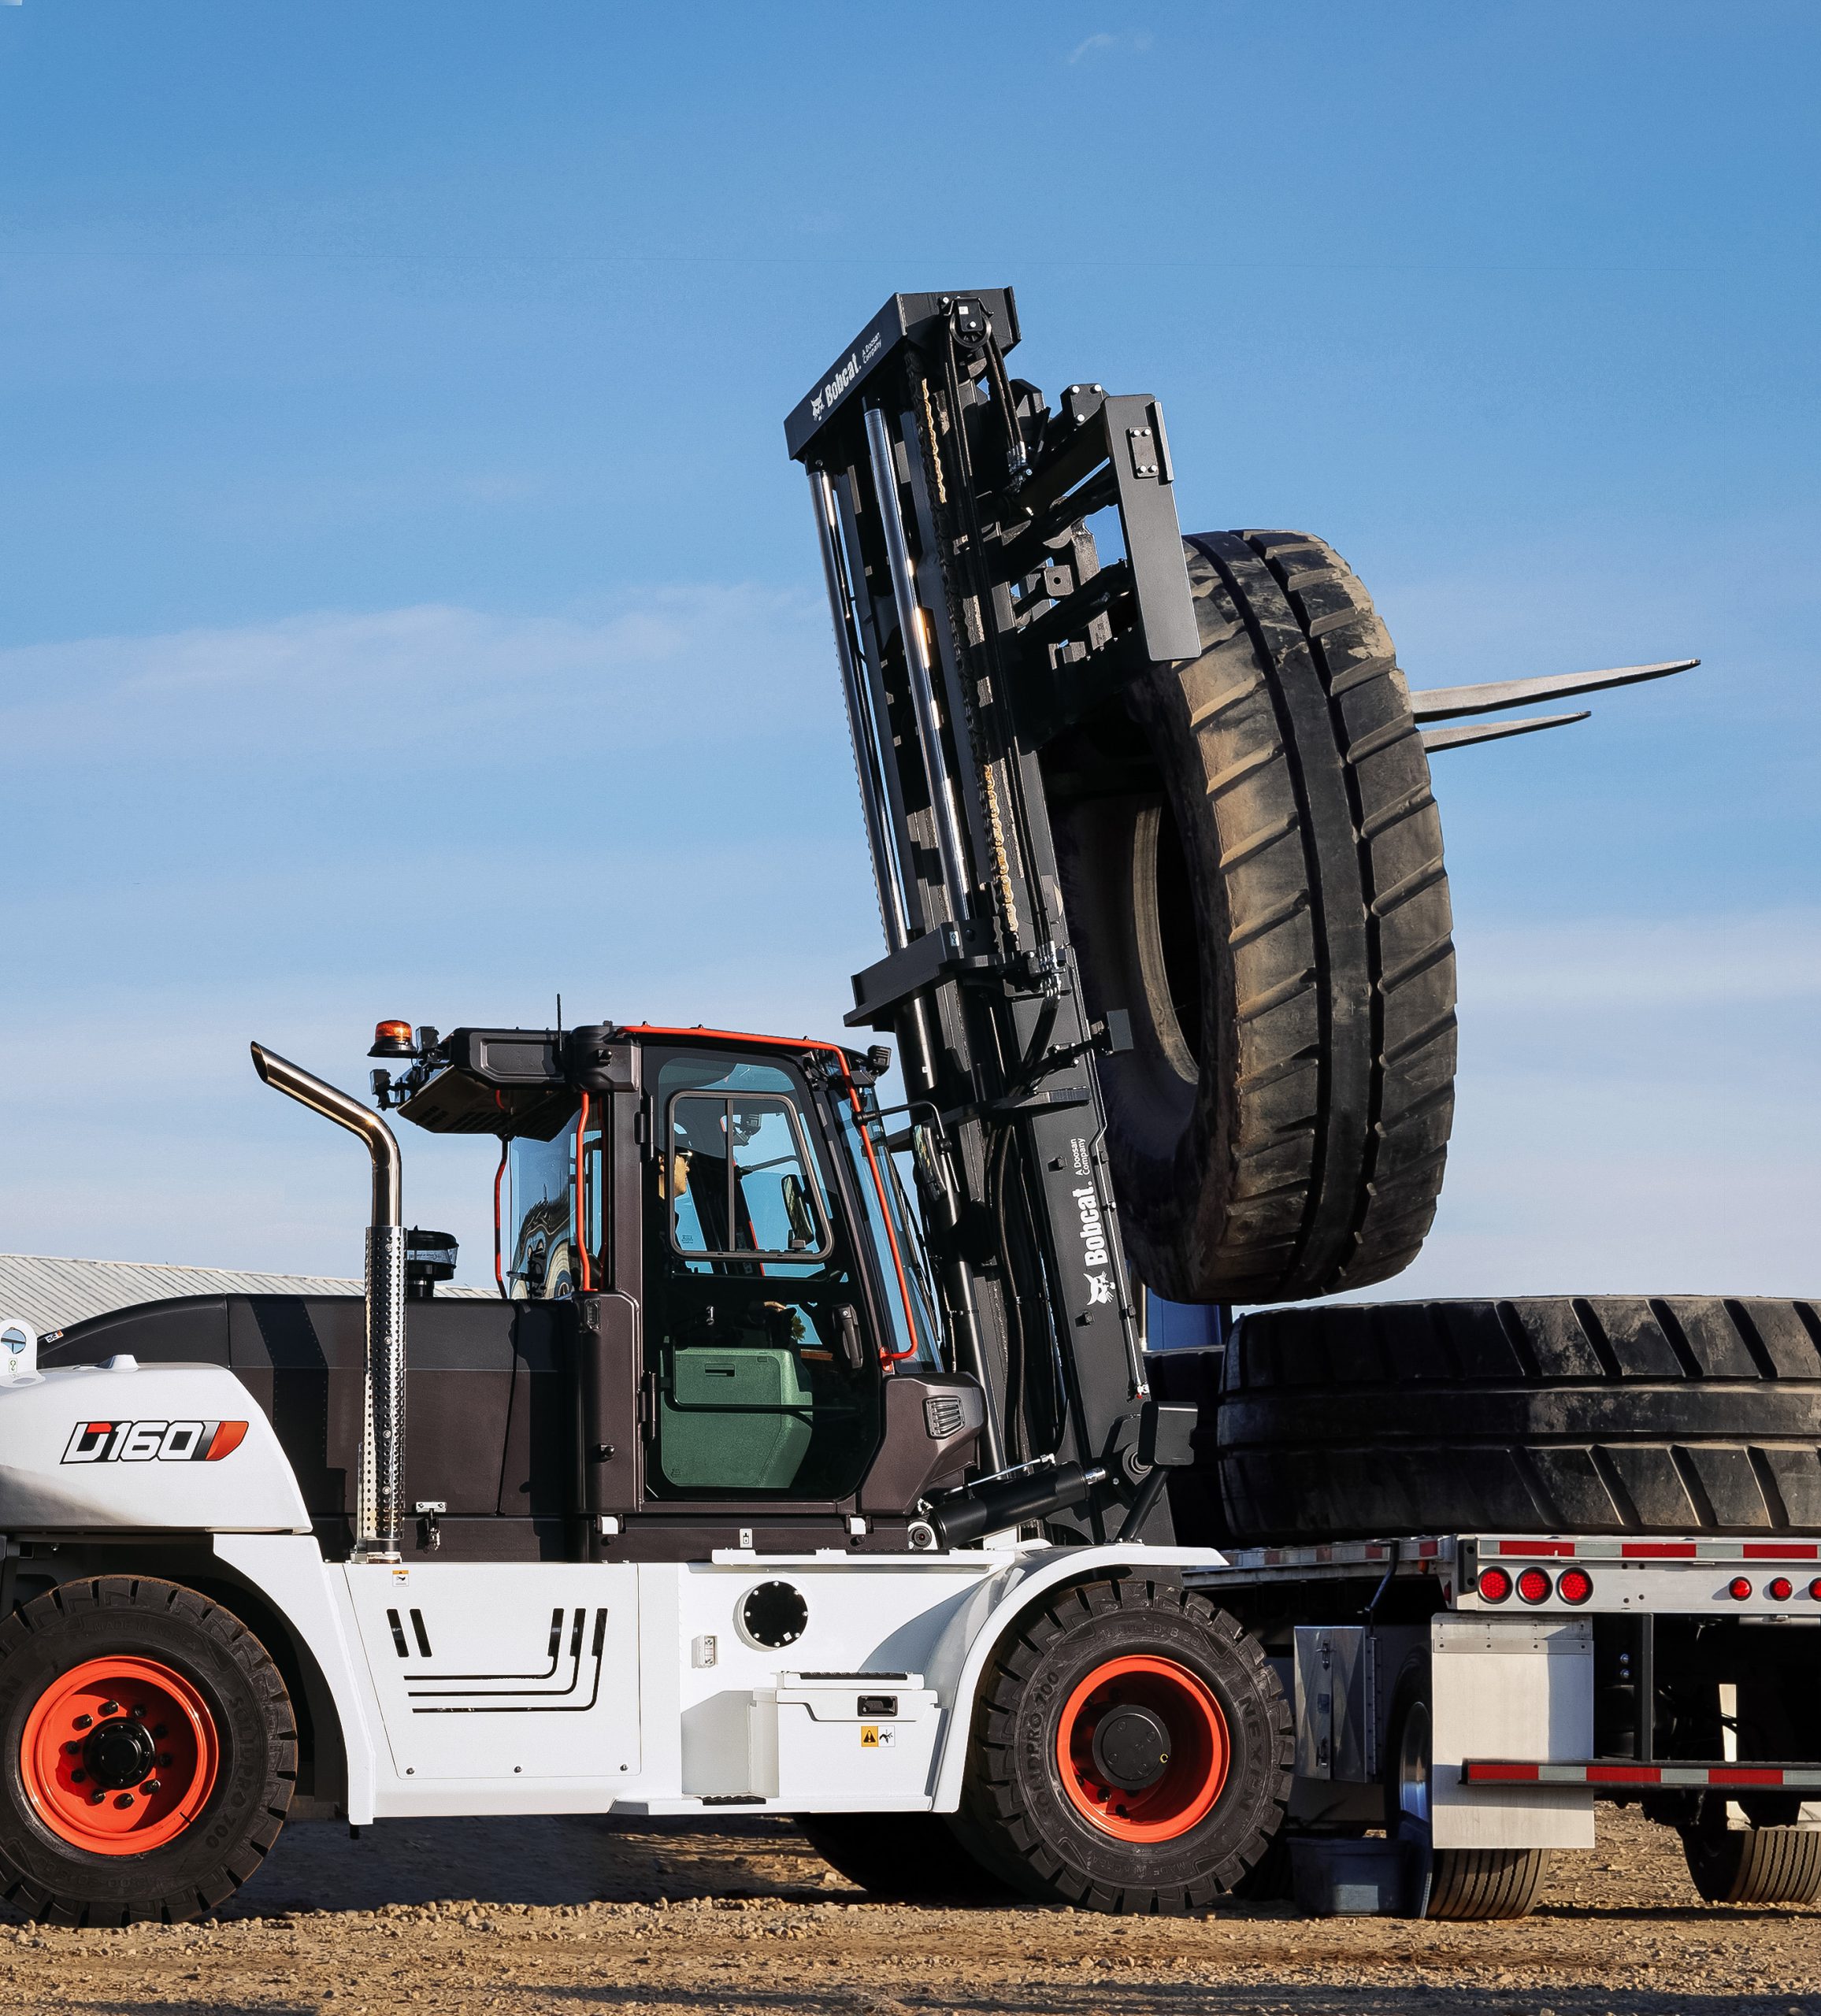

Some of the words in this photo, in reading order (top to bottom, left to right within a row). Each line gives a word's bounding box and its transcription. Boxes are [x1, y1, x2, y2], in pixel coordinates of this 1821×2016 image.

[1070, 1138, 1082, 1169] Doosan
[1077, 1138, 1091, 1176] Company
[61, 1421, 206, 1463] D160
[1034, 1670, 1060, 1707] 700
[229, 1695, 259, 1809] SOLIDPRO
[1237, 1695, 1263, 1812] NEXEN
[206, 1810, 239, 1850] 700
